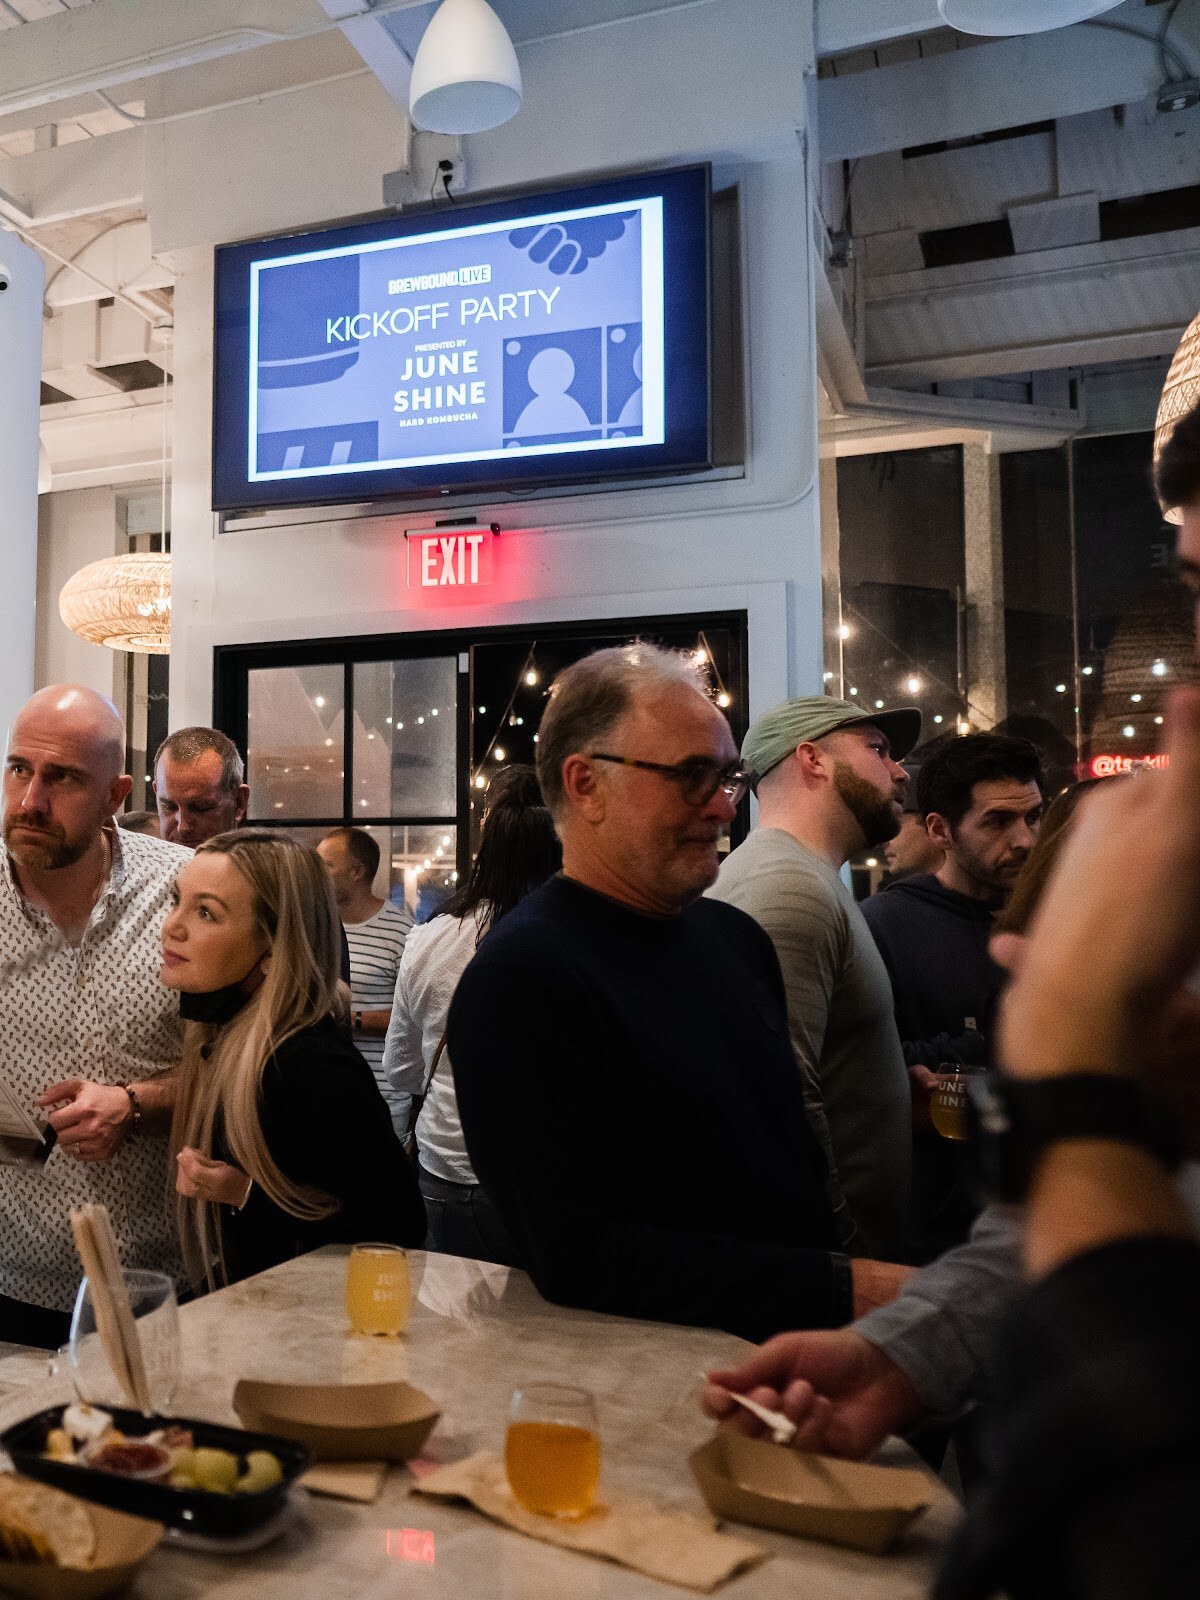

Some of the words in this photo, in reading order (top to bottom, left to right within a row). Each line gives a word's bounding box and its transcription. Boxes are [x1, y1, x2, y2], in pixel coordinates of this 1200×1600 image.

[388, 271, 459, 295] BREWBOUND
[461, 266, 489, 283] LIVE
[326, 302, 450, 344] KICKOFF
[460, 286, 561, 325] PARTY
[415, 340, 456, 353] PRESENTED
[456, 339, 467, 348] BY
[400, 350, 478, 381] JUNE
[393, 381, 486, 413] SHINE
[399, 418, 425, 428] HARD
[427, 412, 478, 425] KOMBUCHA
[421, 535, 483, 587] EXIT
[939, 1081, 967, 1094] UNE
[939, 1095, 968, 1108] INE
